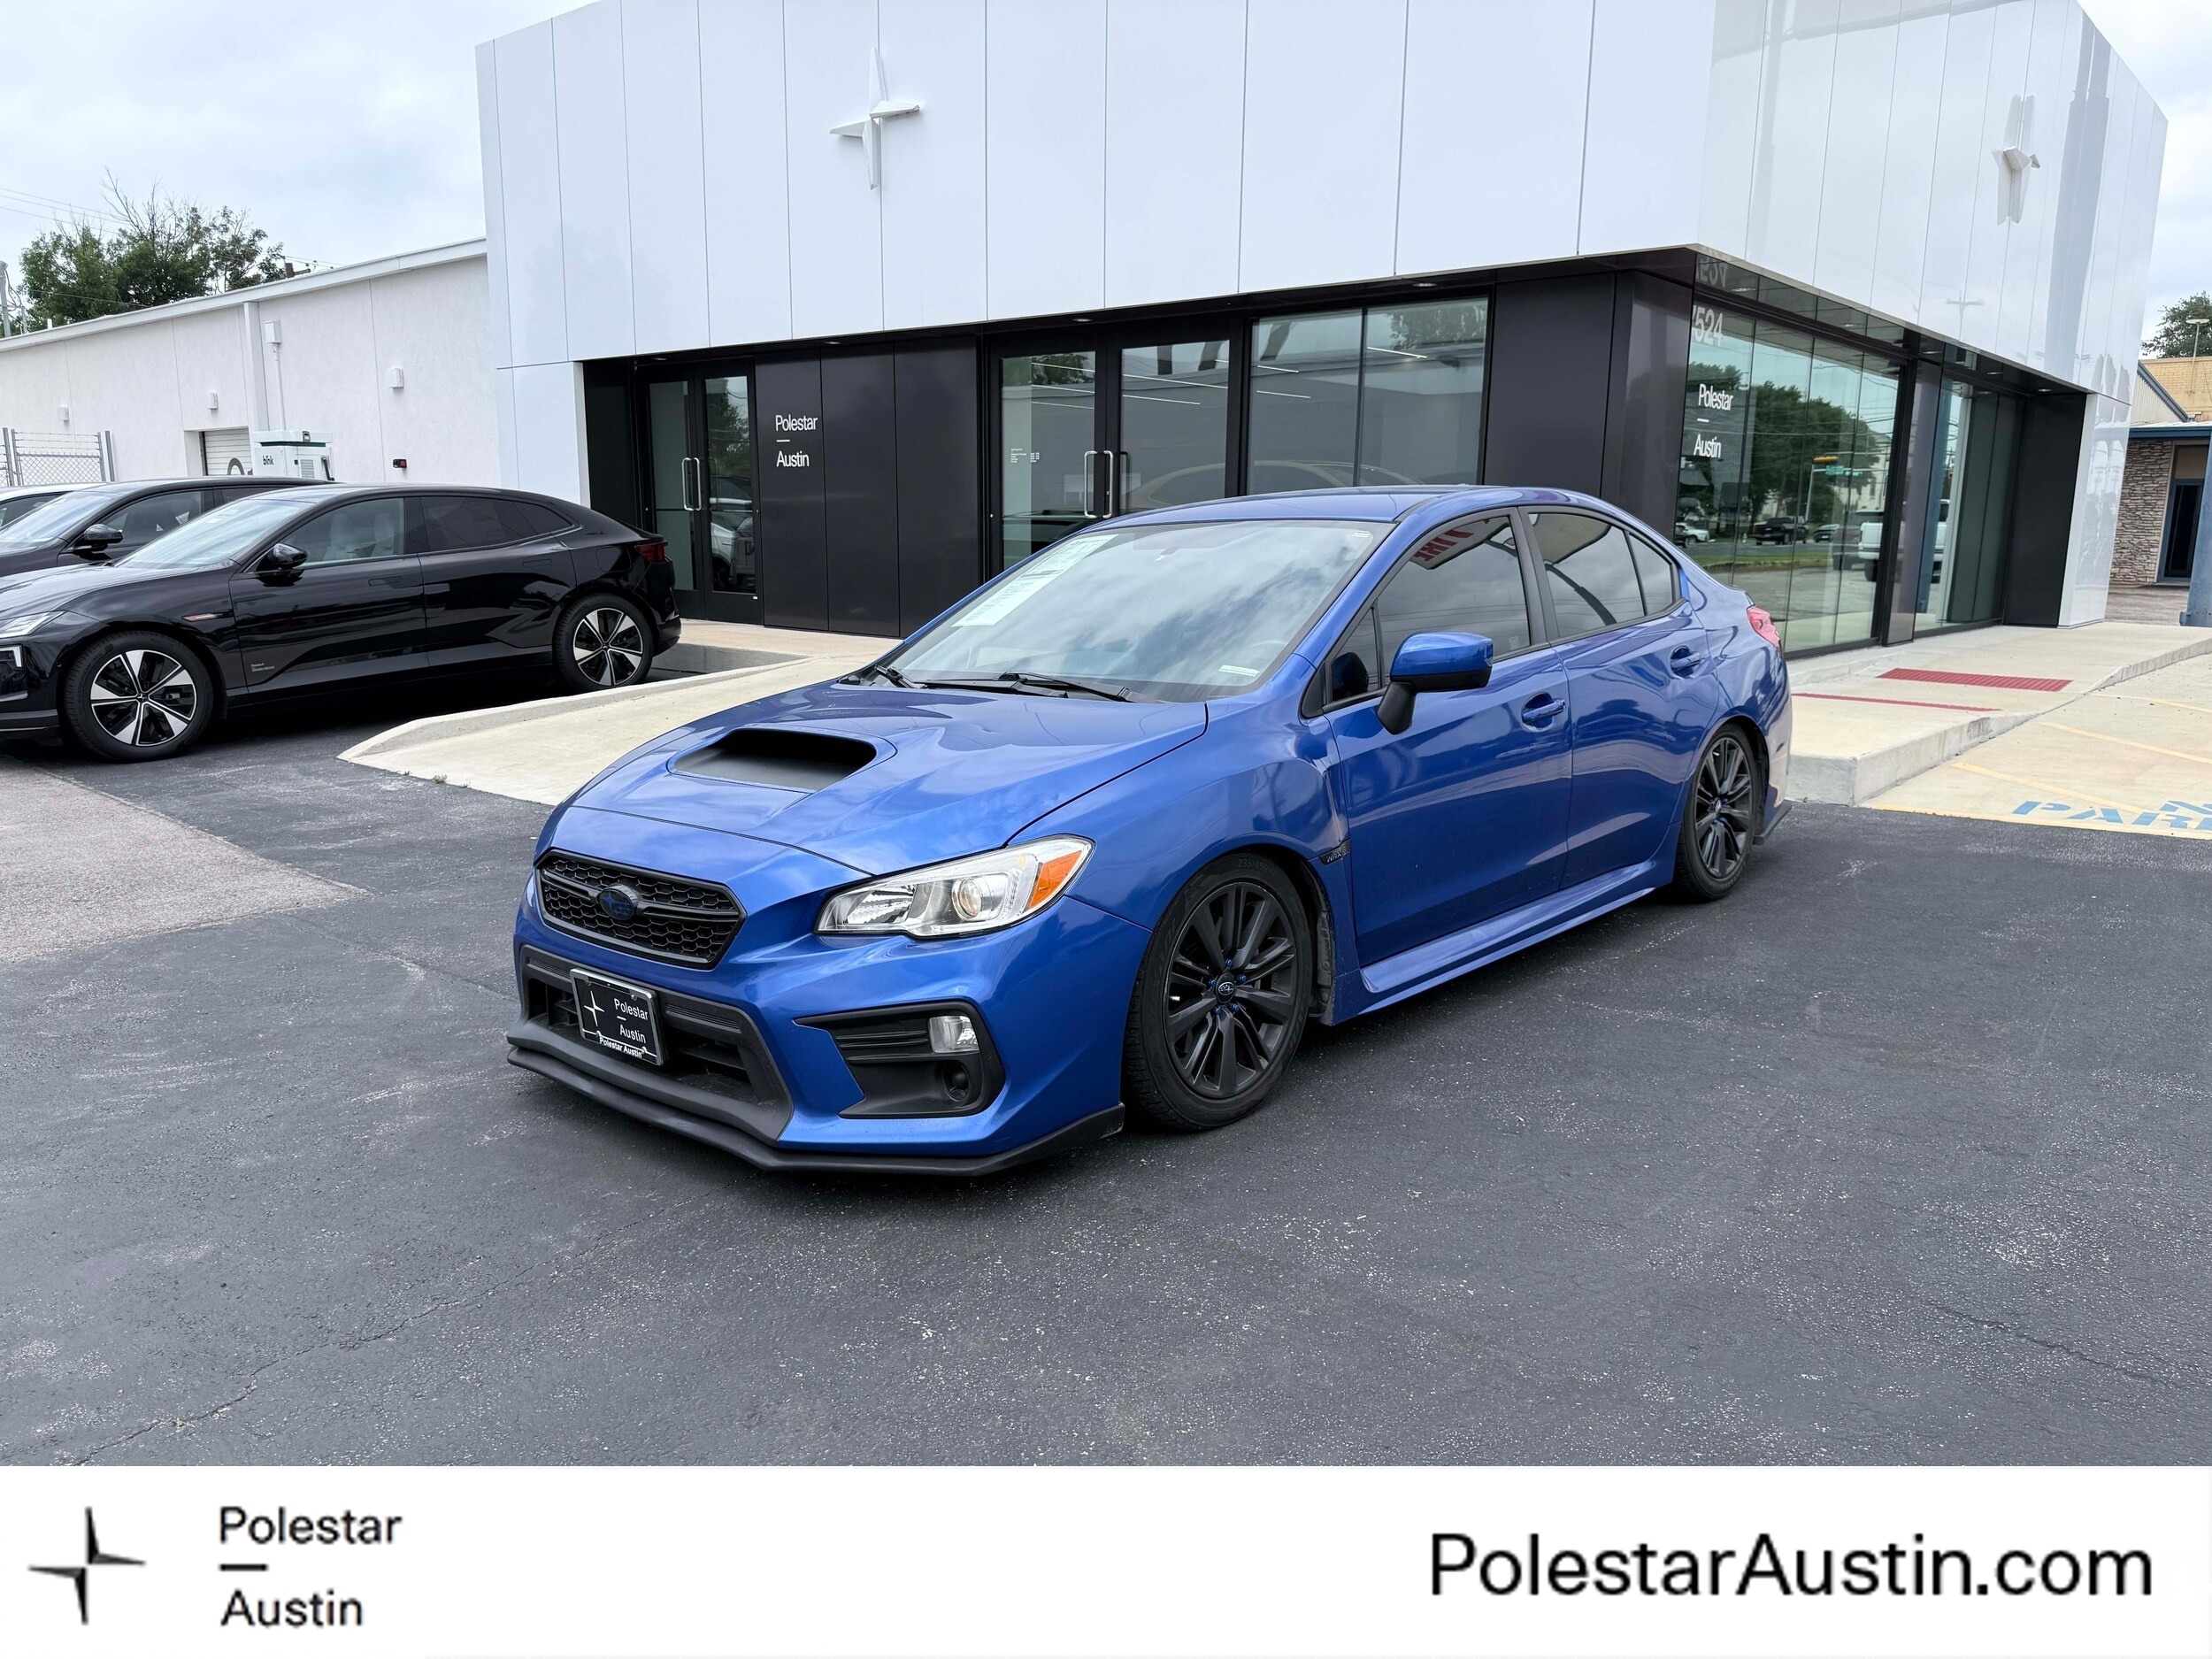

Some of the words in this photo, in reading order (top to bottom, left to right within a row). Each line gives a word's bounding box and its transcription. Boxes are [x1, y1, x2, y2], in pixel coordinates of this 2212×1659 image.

[1699, 383, 1734, 411] Polestar
[775, 413, 818, 432] Polestar
[1693, 434, 1722, 458] Austin
[776, 449, 810, 467] Austin
[613, 997, 649, 1021] Polestar
[619, 1024, 647, 1044] Austin
[599, 1037, 623, 1052] Polestar
[623, 1044, 642, 1058] Austin
